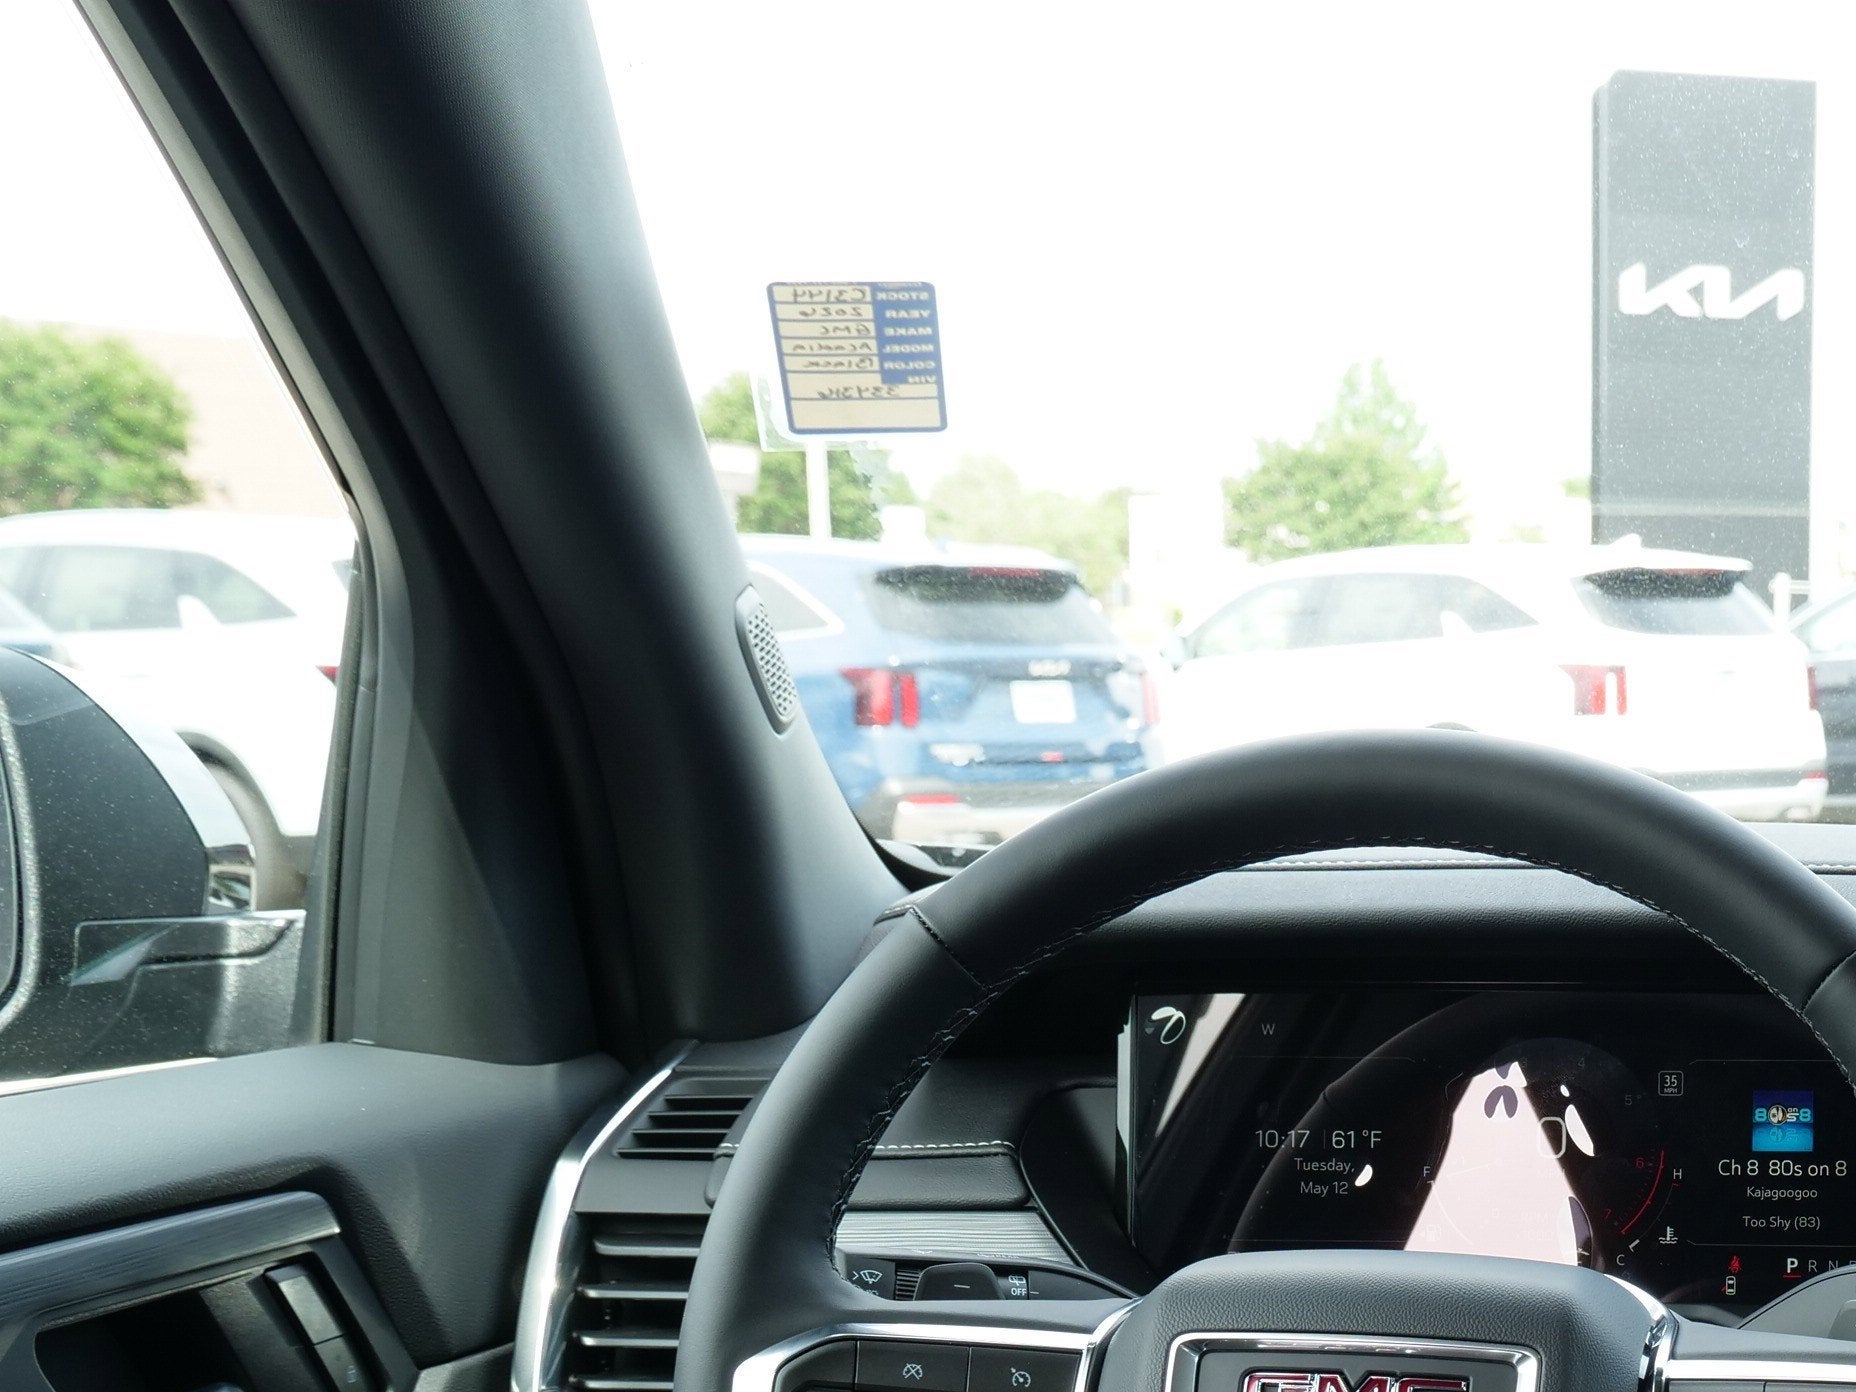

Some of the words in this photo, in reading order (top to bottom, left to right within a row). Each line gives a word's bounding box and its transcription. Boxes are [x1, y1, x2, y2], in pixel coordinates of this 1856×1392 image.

[1261, 1023, 1275, 1035] W
[1663, 1075, 1678, 1088] 35
[1255, 1130, 1310, 1149] 10:17
[1294, 1157, 1356, 1174] Tuesday,
[1635, 1157, 1645, 1168] 6
[1718, 1159, 1741, 1176] Ch
[1746, 1161, 1759, 1176] 8
[1769, 1160, 1803, 1176] 80s
[1808, 1165, 1830, 1176] on
[1835, 1161, 1848, 1176] 8
[1423, 1167, 1431, 1177] F
[1673, 1169, 1682, 1180] H
[1300, 1181, 1328, 1197] May
[1331, 1181, 1349, 1195] 12
[1746, 1187, 1818, 1200] Kajagoogoo
[1742, 1217, 1766, 1228] Too
[1769, 1217, 1791, 1231] Shy
[1794, 1216, 1821, 1231] (83)
[1616, 1255, 1625, 1266] C
[1786, 1258, 1799, 1274] P
[1808, 1260, 1818, 1273] R
[1011, 1288, 1027, 1296] OFF
